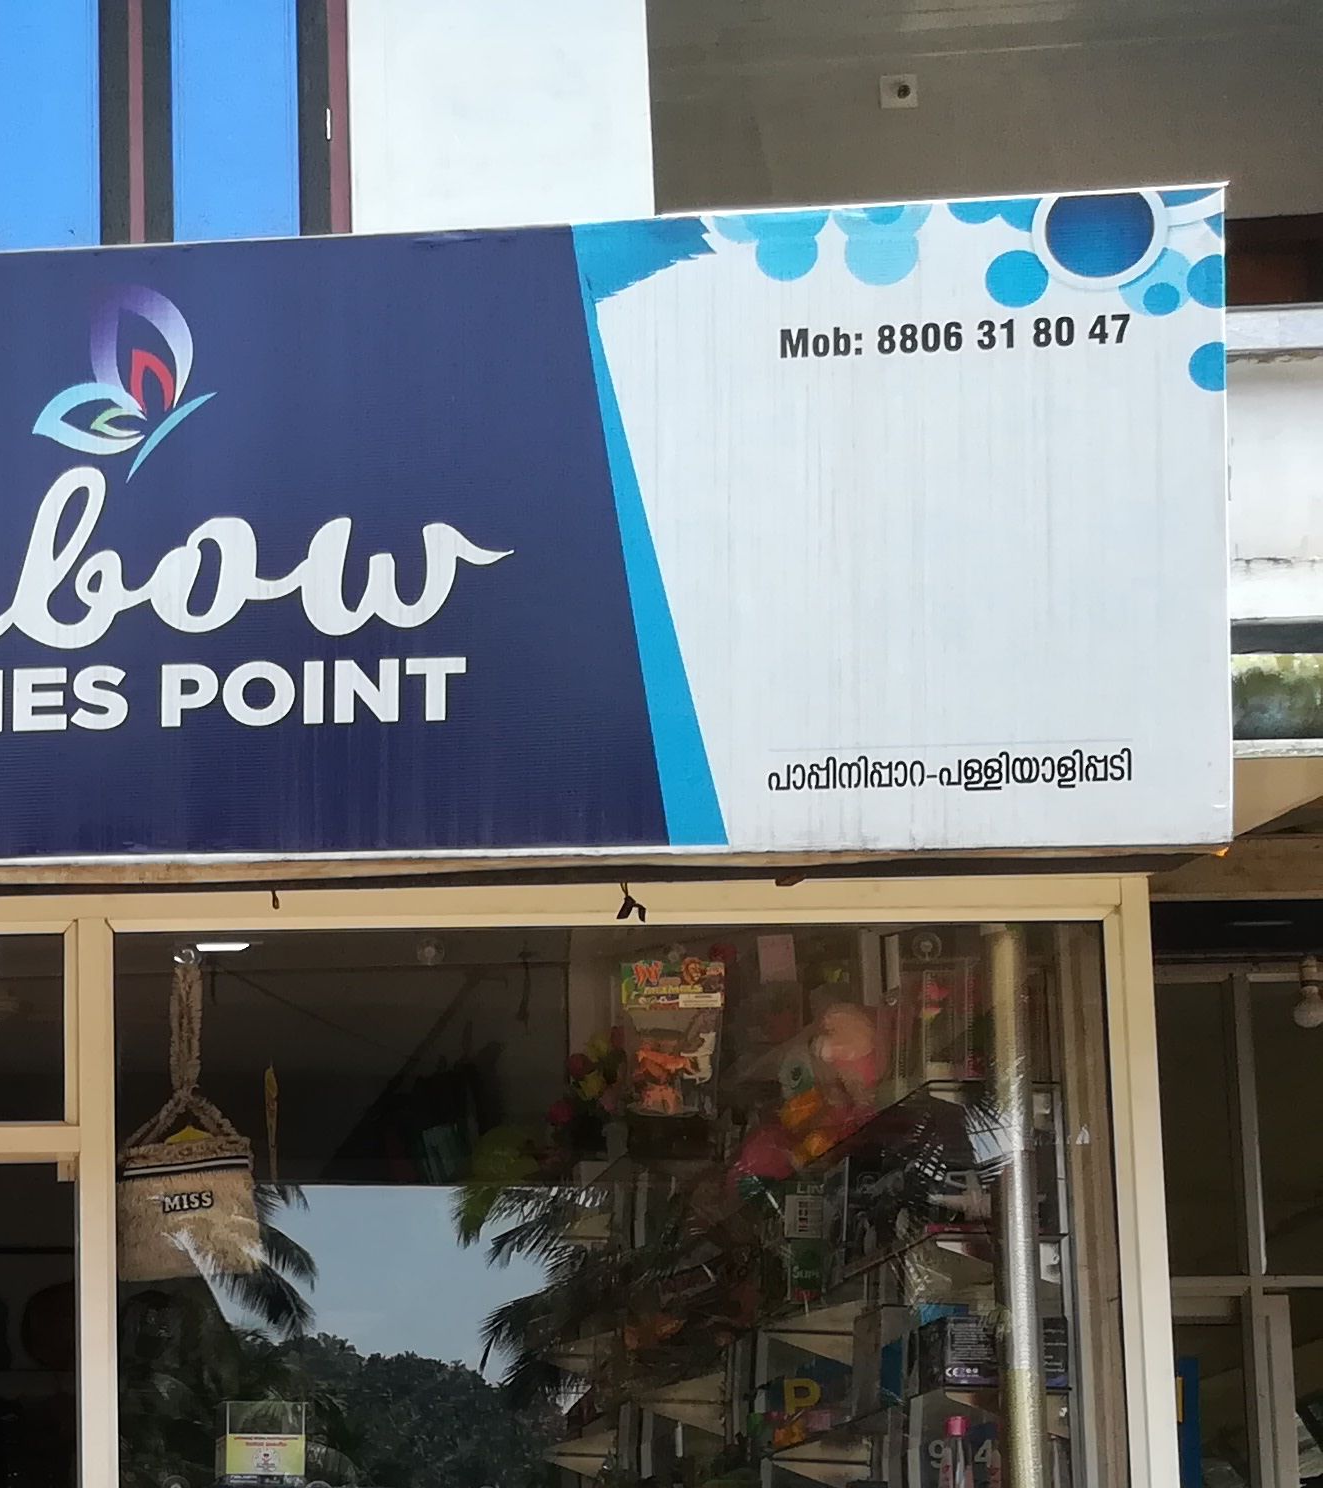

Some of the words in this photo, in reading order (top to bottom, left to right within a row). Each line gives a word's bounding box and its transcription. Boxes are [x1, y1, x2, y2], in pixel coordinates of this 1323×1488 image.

[779, 326, 863, 360] Mob:
[877, 321, 963, 355] 8806
[977, 319, 1016, 351] 31
[1032, 317, 1076, 349] 80
[1088, 314, 1132, 346] 47
[160, 657, 467, 729] POINT
[161, 1190, 214, 1213] MISS
